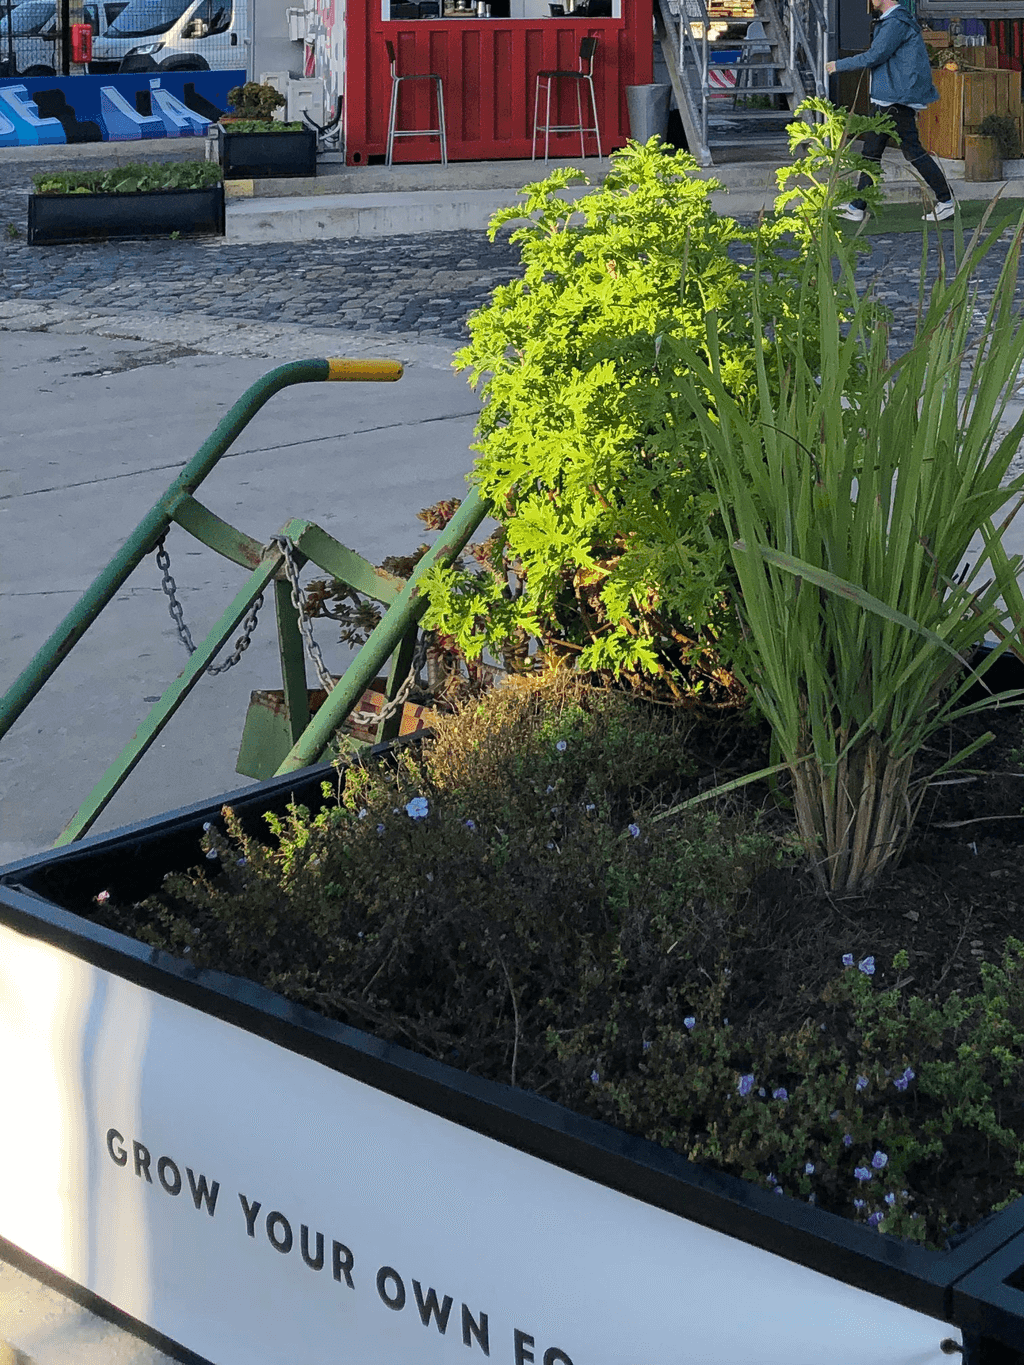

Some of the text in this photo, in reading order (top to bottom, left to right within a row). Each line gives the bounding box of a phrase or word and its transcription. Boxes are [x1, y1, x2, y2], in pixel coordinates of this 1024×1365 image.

[106, 1127, 220, 1217] GROW
[237, 1192, 355, 1290] YOUR
[376, 1265, 490, 1357] OWN
